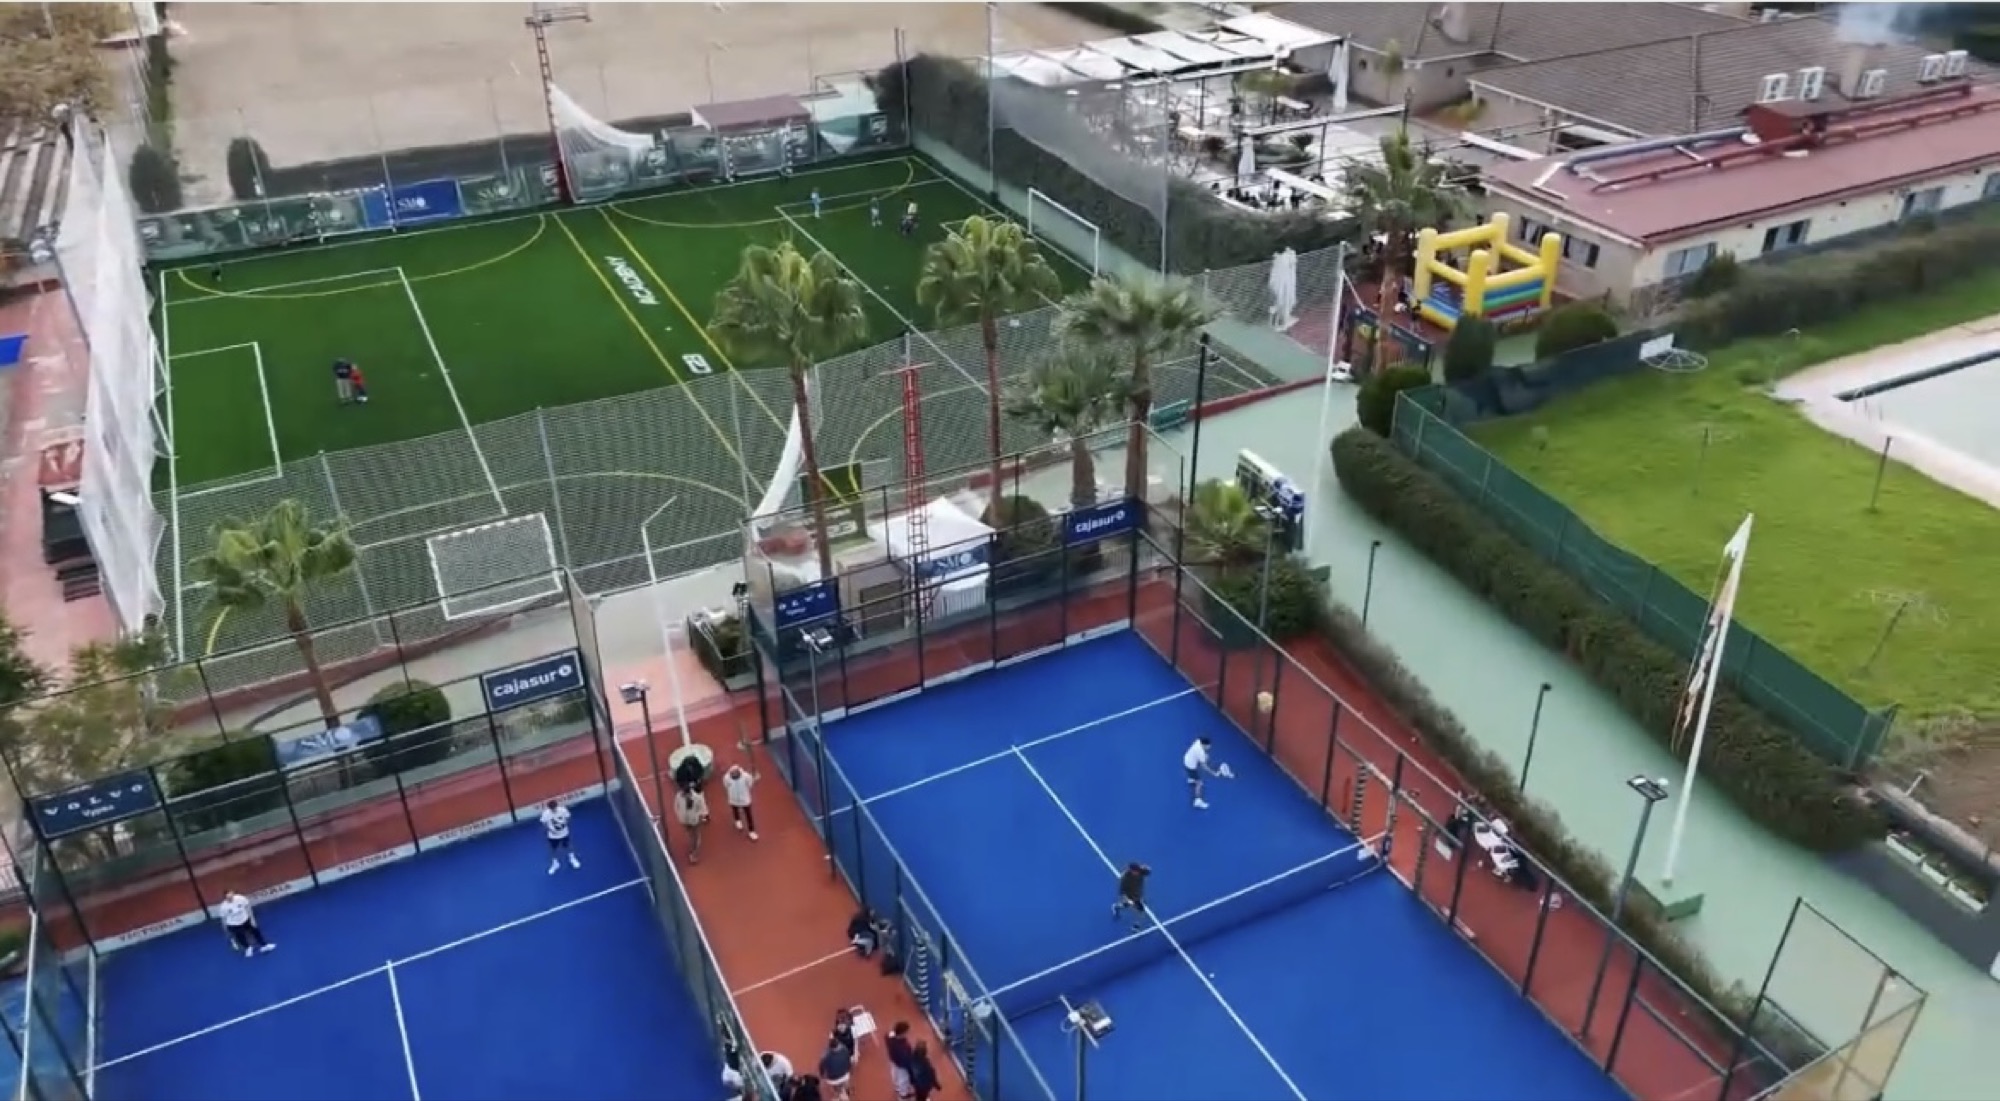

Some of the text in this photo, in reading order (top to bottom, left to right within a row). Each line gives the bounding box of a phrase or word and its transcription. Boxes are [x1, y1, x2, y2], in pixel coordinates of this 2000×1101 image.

[493, 671, 557, 697] cajasur
[44, 784, 143, 815] VOLVO
[119, 917, 184, 943] VICTORIA
